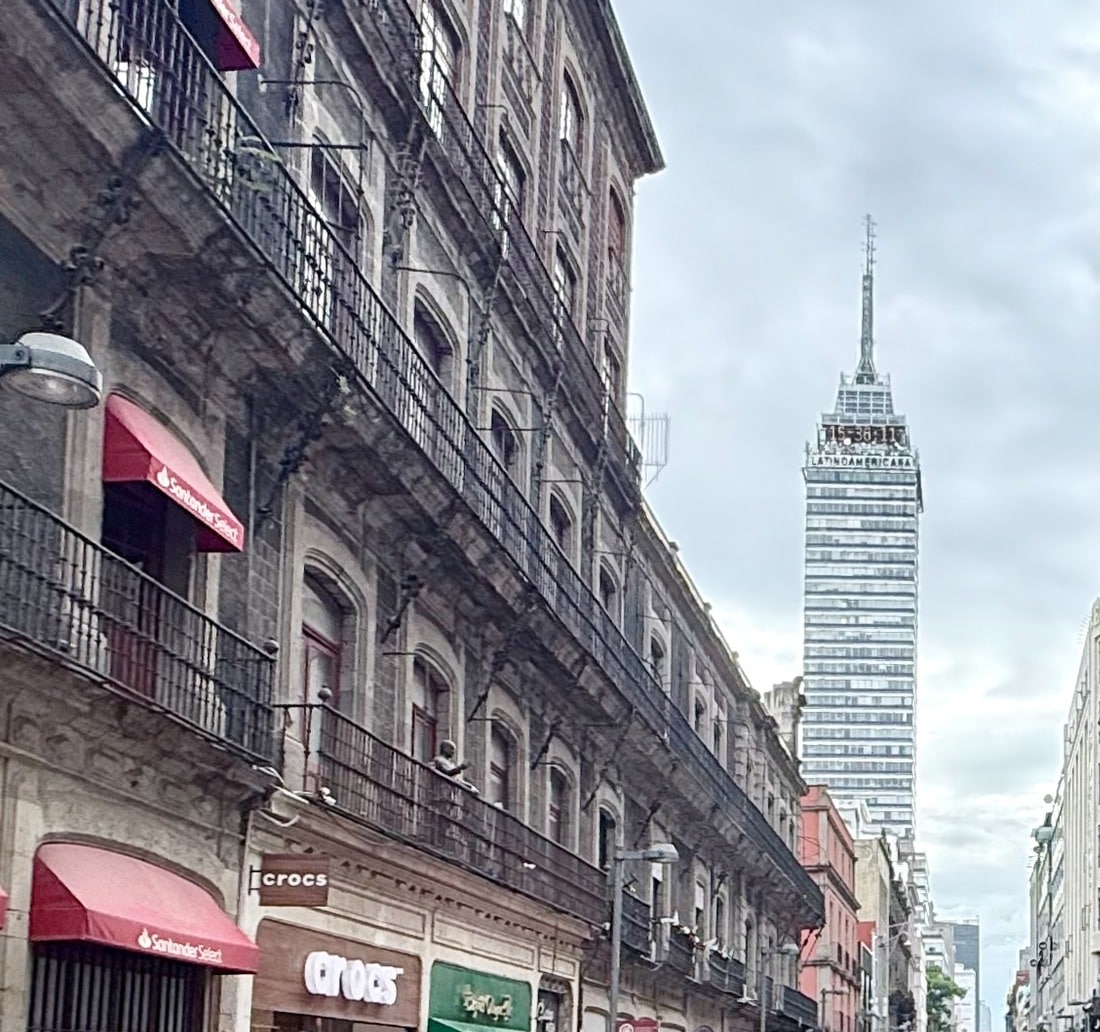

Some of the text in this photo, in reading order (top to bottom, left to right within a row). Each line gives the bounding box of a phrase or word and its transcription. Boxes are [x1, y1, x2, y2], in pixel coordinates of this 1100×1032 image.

[170, 477, 238, 540] Santander Select
[263, 872, 328, 887] crocs
[151, 933, 223, 963] Santander Select
[304, 951, 400, 1006] crocs
